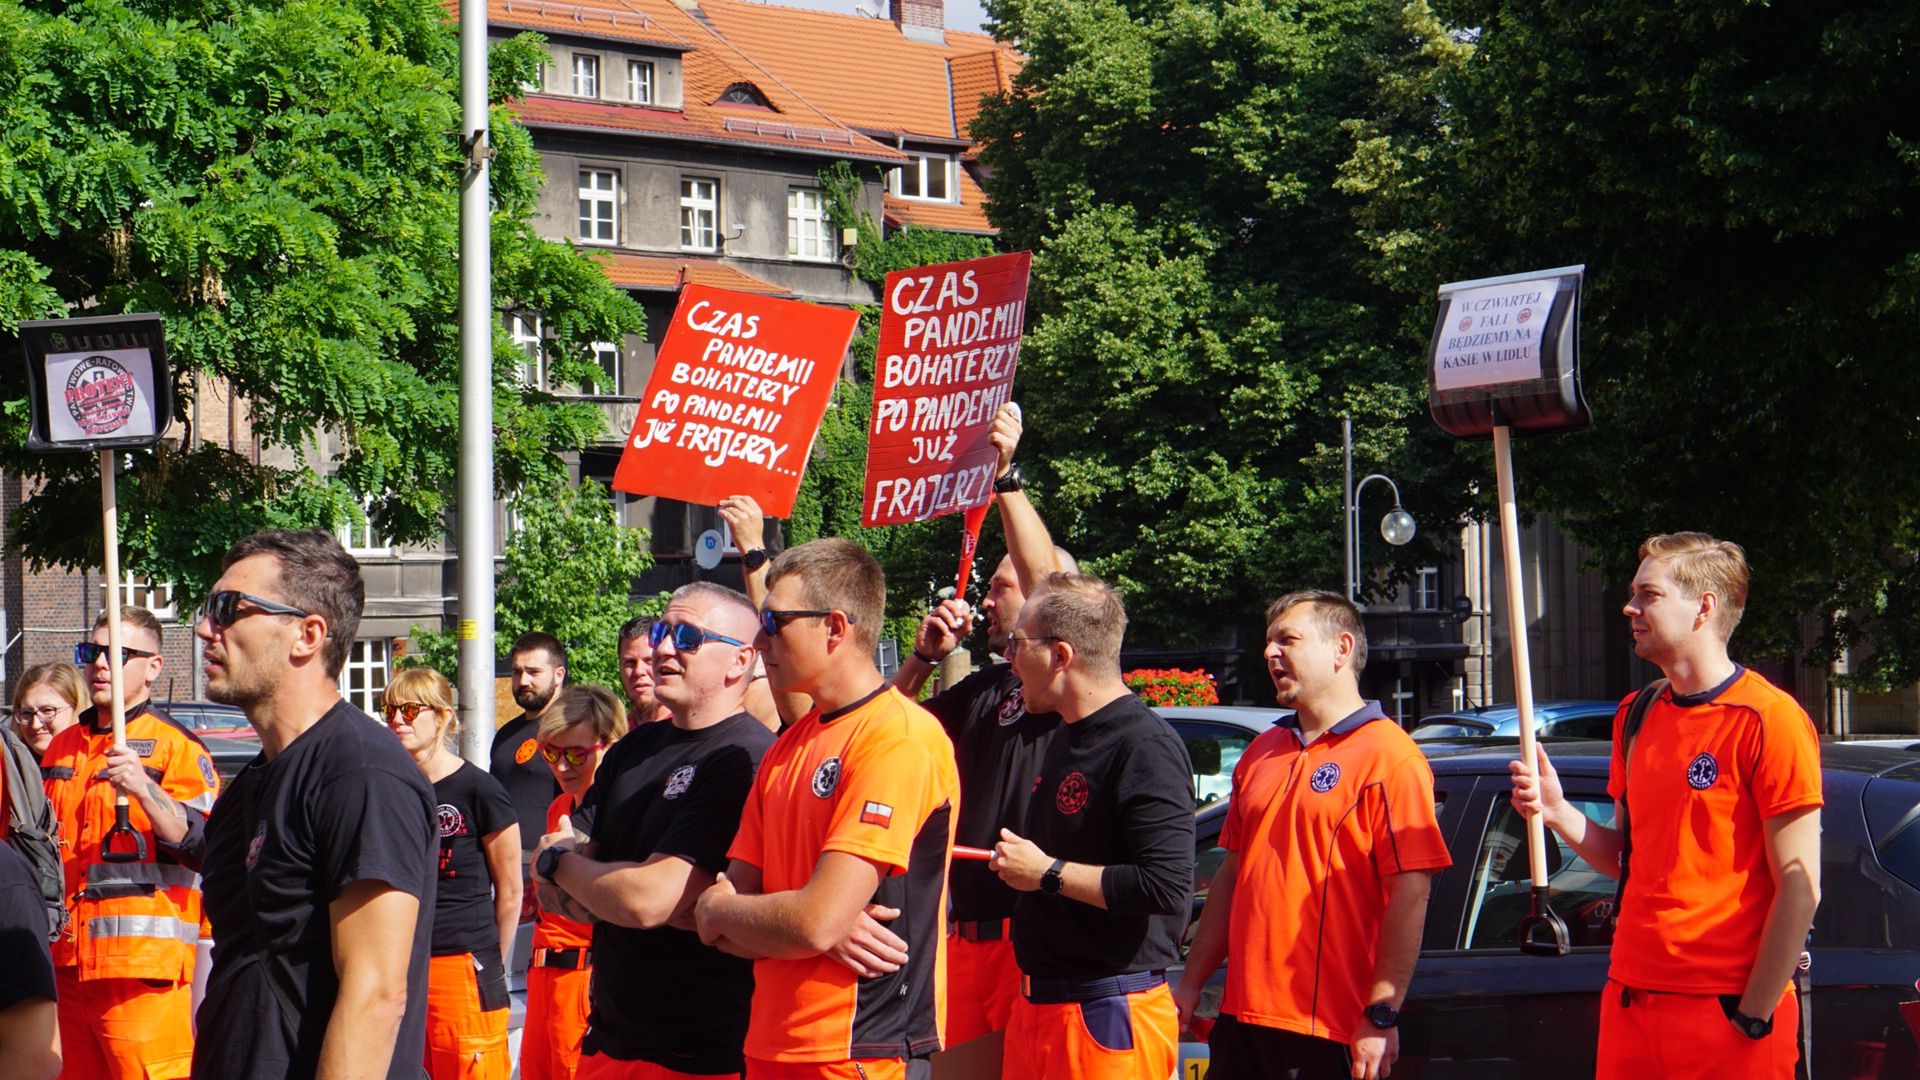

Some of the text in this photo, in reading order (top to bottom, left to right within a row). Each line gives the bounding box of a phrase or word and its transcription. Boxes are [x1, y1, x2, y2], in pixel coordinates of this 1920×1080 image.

[891, 269, 979, 316] CZAS
[1462, 292, 1542, 313] W CZWARTEJ
[687, 300, 760, 338] CZAS
[904, 300, 1023, 351] PANDEMII
[1448, 328, 1531, 351] BĘDZIEMY NA
[1480, 313, 1508, 328] FALI
[701, 338, 815, 385] PANDEMII
[884, 340, 1019, 388] BOHATERZY
[1443, 346, 1532, 369] KASIE W LIDLU
[670, 362, 800, 406] BOHATERZY
[651, 389, 783, 434] PO PANDEMII
[876, 383, 1008, 434] PO PANDEMII
[633, 418, 677, 448] JUŻ
[907, 429, 958, 464] JUŻ
[871, 462, 995, 521] FRAJERZY
